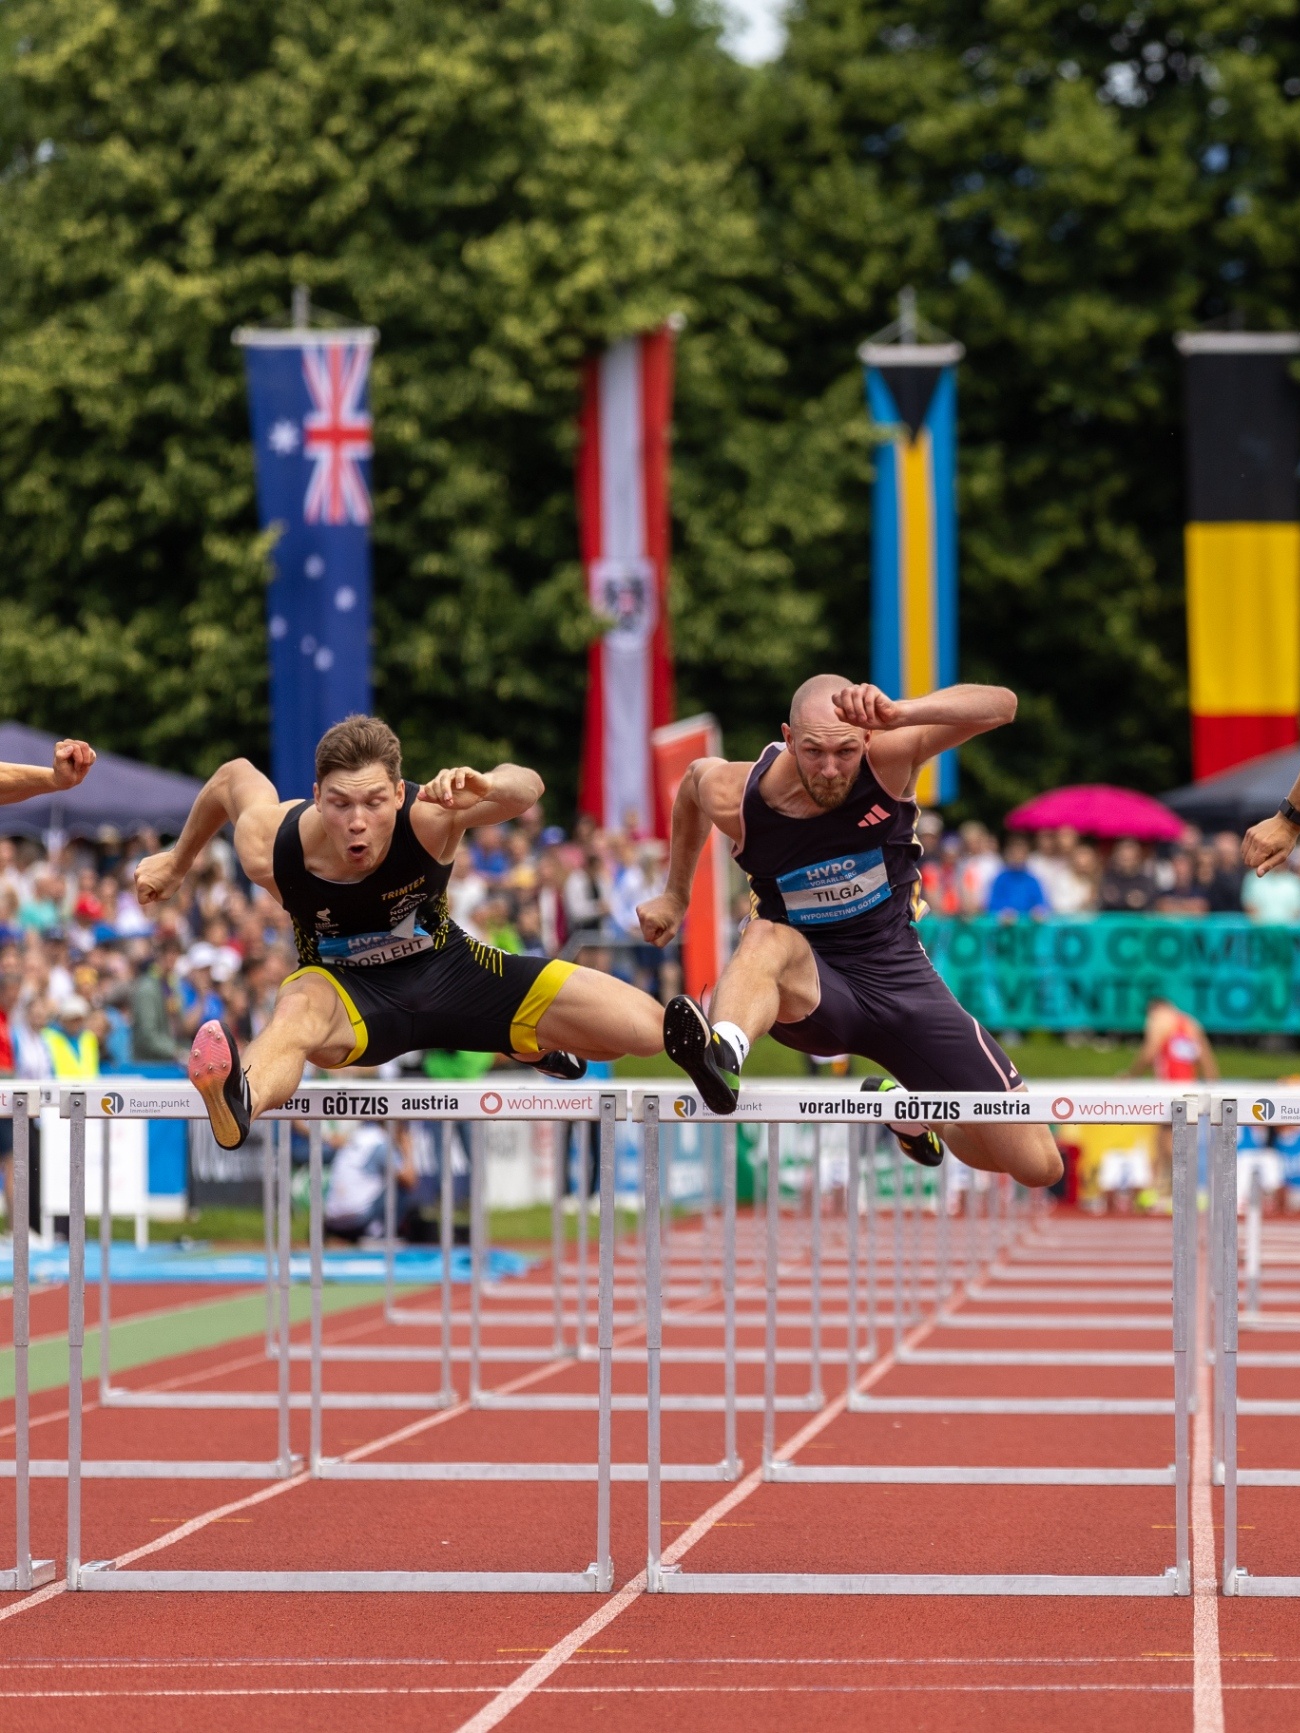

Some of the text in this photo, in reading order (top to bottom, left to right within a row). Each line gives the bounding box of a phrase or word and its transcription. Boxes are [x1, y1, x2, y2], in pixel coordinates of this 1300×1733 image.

[806, 859, 857, 881] HYPO
[809, 870, 858, 888] VORARLBERG
[381, 875, 426, 901] TRIMTEX
[813, 883, 864, 903] TILGA
[800, 905, 857, 921] HYPOMEETING
[129, 1098, 190, 1109] Raum.punkt
[322, 1093, 389, 1115] GÖTZIS
[401, 1094, 459, 1111] austria
[507, 1096, 593, 1110] wohn.wert
[799, 1097, 1030, 1119] vorarlberg GÖTZIS austria
[1079, 1101, 1165, 1116] wohn.wert
